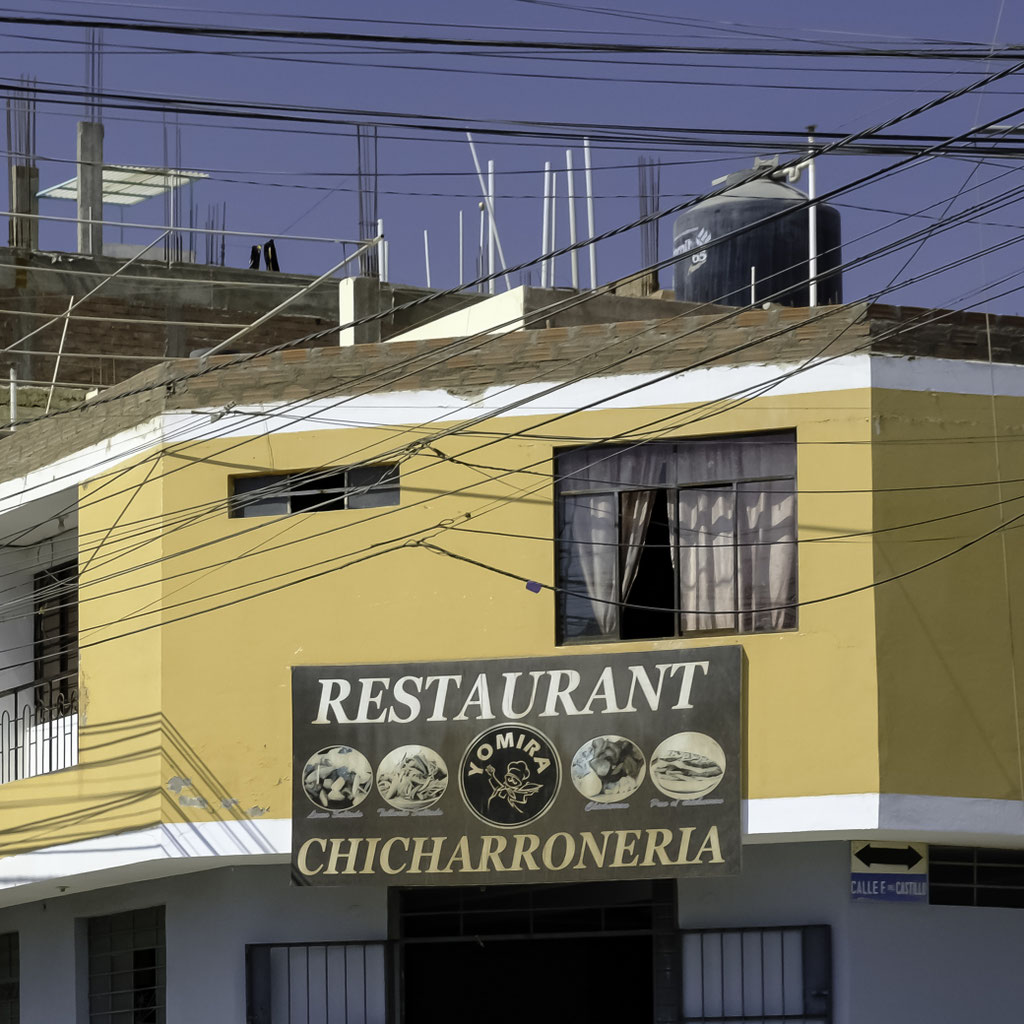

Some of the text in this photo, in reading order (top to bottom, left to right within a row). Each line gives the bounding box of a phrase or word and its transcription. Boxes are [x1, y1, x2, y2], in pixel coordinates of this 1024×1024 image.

[311, 661, 709, 724] RESTAURANT
[468, 732, 551, 776] YOMIRA
[297, 825, 725, 876] CHICHARRONERIA
[851, 881, 878, 895] CALLE
